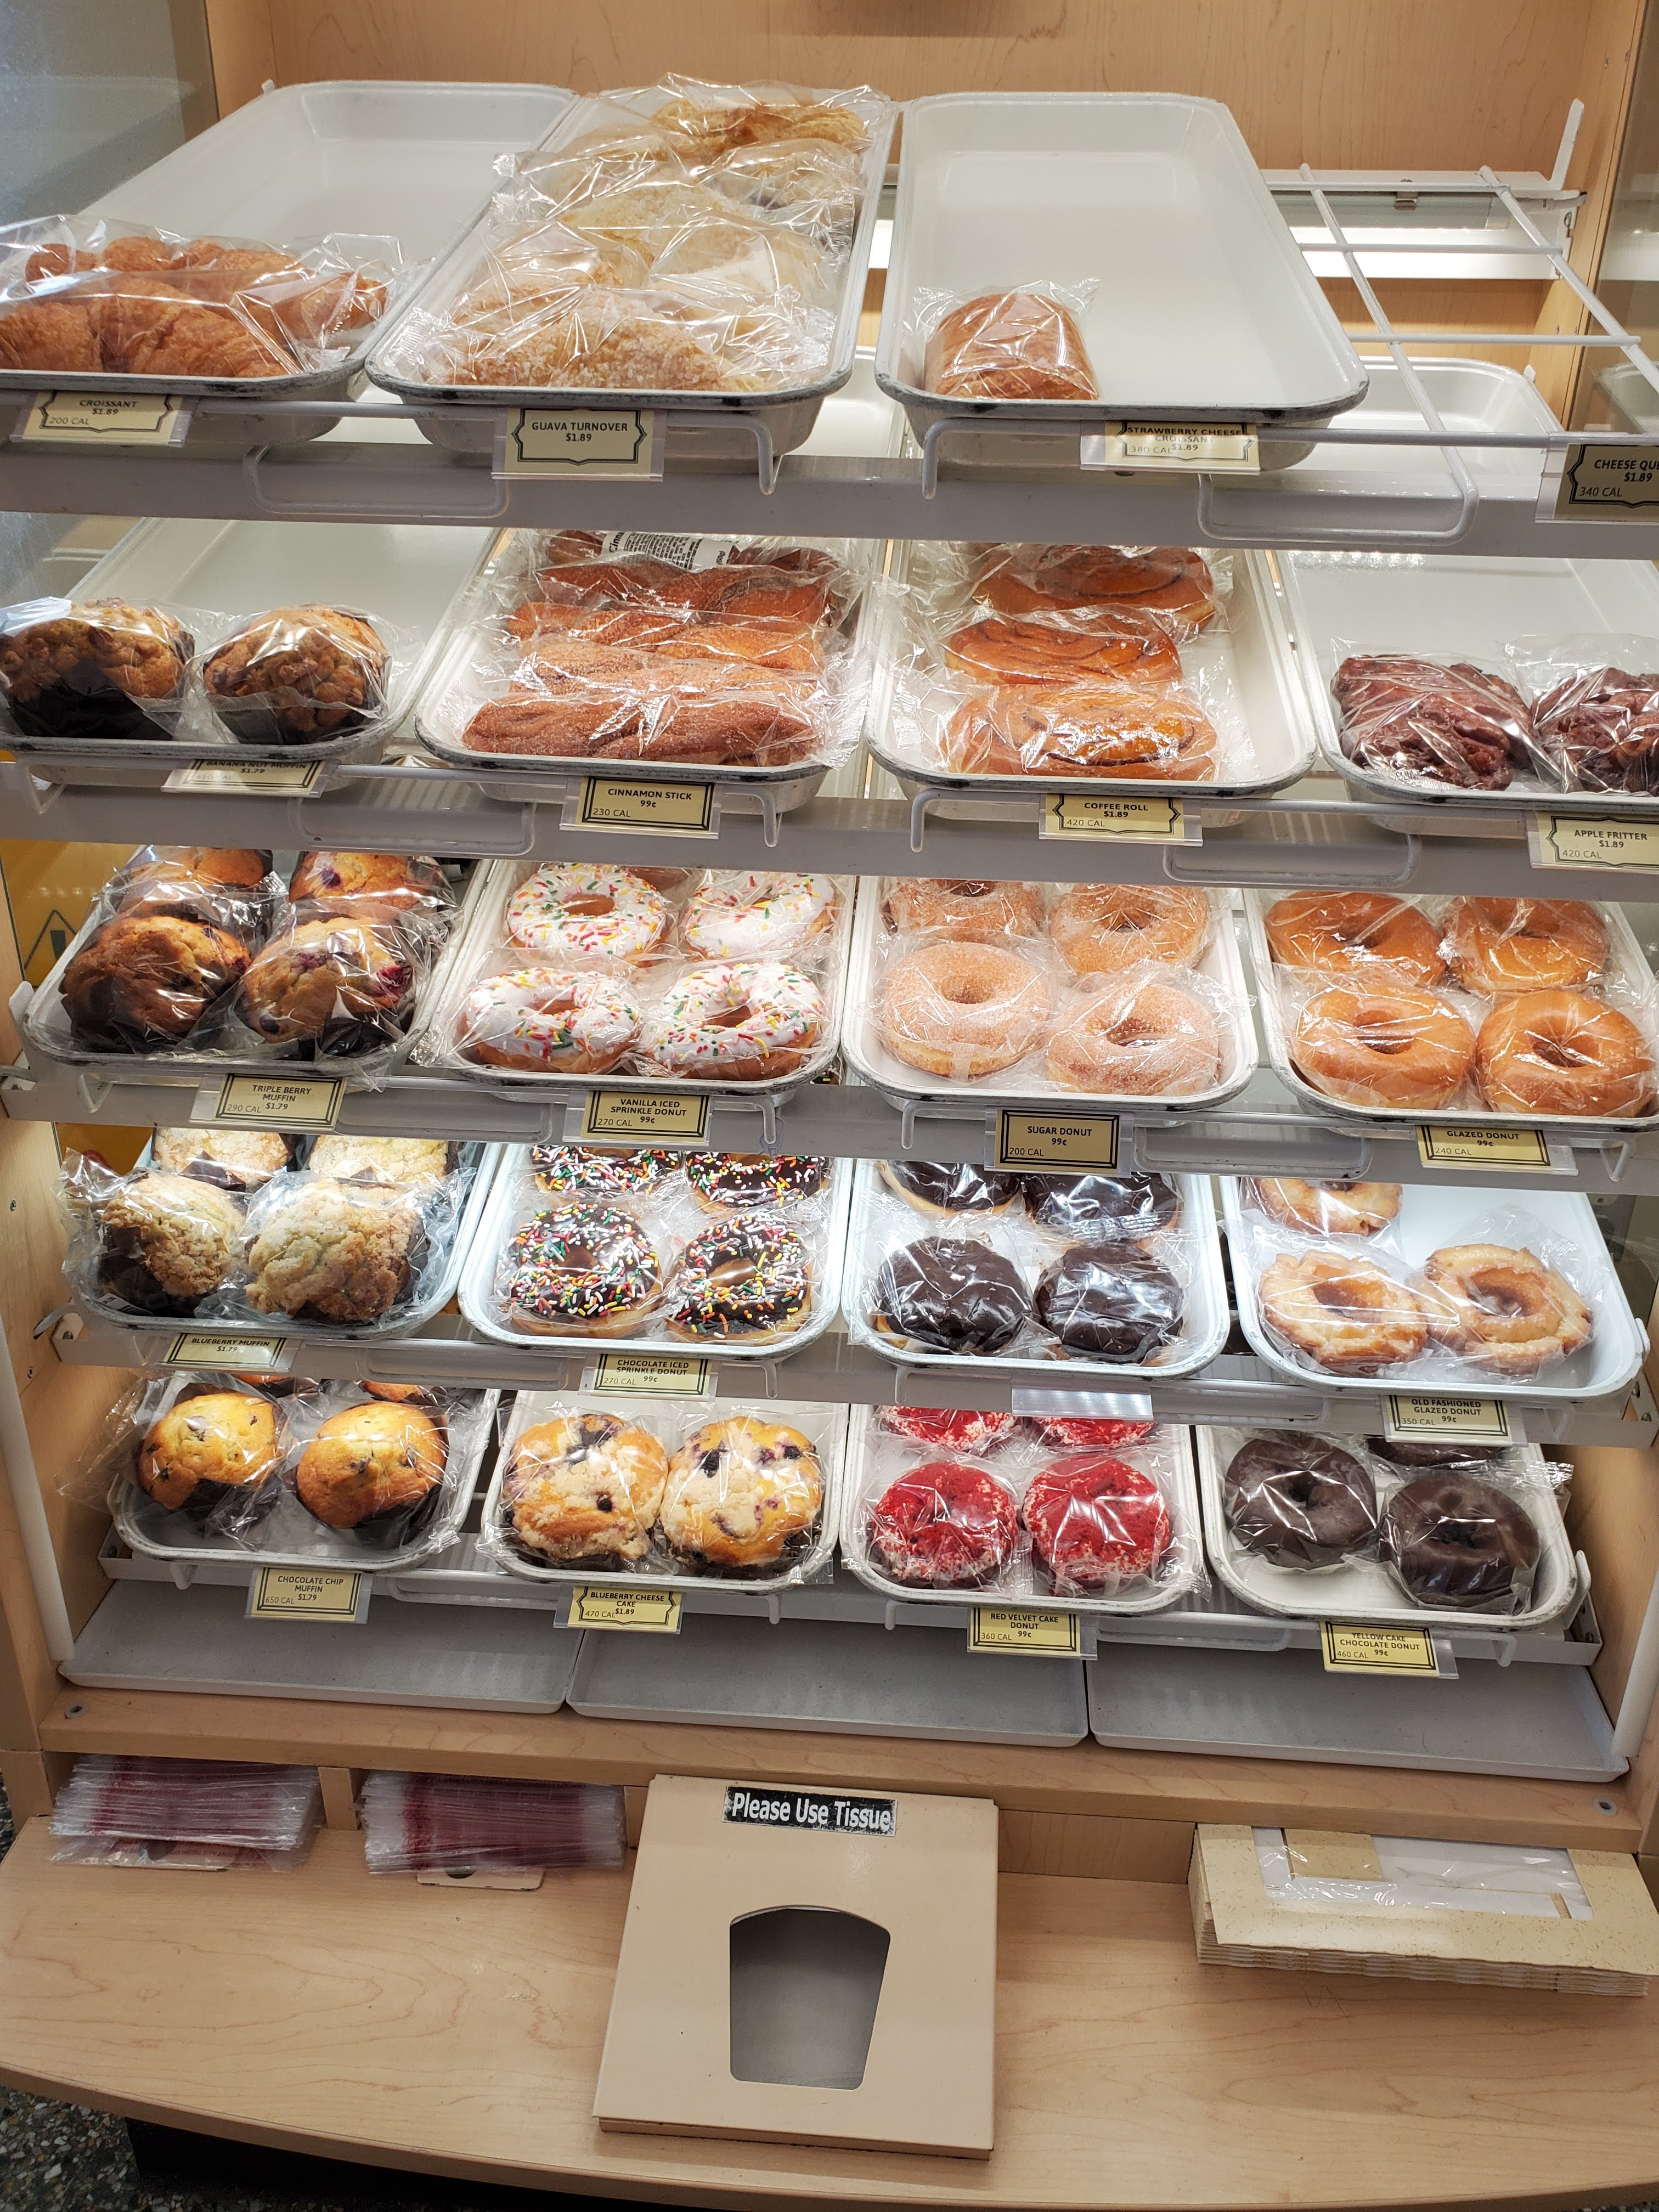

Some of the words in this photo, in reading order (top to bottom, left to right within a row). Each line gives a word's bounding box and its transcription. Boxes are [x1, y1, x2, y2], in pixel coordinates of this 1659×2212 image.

[79, 399, 137, 408] CROISSANT
[532, 422, 567, 431] GUAVA
[571, 422, 628, 431] TURNOVER
[1127, 427, 1198, 435] STRAWBERRY
[566, 433, 592, 442] $1.89
[1153, 447, 1171, 455] CAL
[1594, 459, 1637, 470] CHEESE
[1624, 472, 1652, 482] $1.89
[1579, 487, 1599, 496] 340
[1602, 487, 1622, 497] CAL
[609, 532, 624, 552] Cinna
[716, 551, 726, 565] (68g)
[608, 788, 662, 798] CINNAMON
[665, 792, 692, 800] STICK
[592, 808, 610, 816] 230
[613, 809, 631, 817] CAL
[1574, 830, 1604, 838] APPLE
[1607, 831, 1647, 840] FRITTER
[1599, 840, 1624, 848] $1.89
[252, 1085, 281, 1093] TRIPLE
[284, 1086, 312, 1095] BERRY
[263, 1093, 296, 1102] MUFFIN
[620, 1098, 657, 1107] VANILLA
[611, 1106, 652, 1115] SPRINKLE
[654, 1108, 687, 1116] DONUT
[616, 1119, 633, 1127] CAL
[1027, 1126, 1057, 1135] SUGAR
[1059, 1127, 1092, 1136] DONUT
[1028, 1148, 1044, 1156] CAL
[617, 1359, 668, 1368] CHOCOLATE
[1431, 1400, 1481, 1408] FASHIONED
[278, 1576, 323, 1584] CHOCOLATE
[1008, 1614, 1037, 1622] VELVET
[1351, 1632, 1385, 1640] YELLOW
[1340, 1639, 1389, 1649] CHOCOLATE
[731, 1792, 791, 1821] Please
[795, 1797, 829, 1824] Use
[834, 1801, 891, 1831] Tissue
